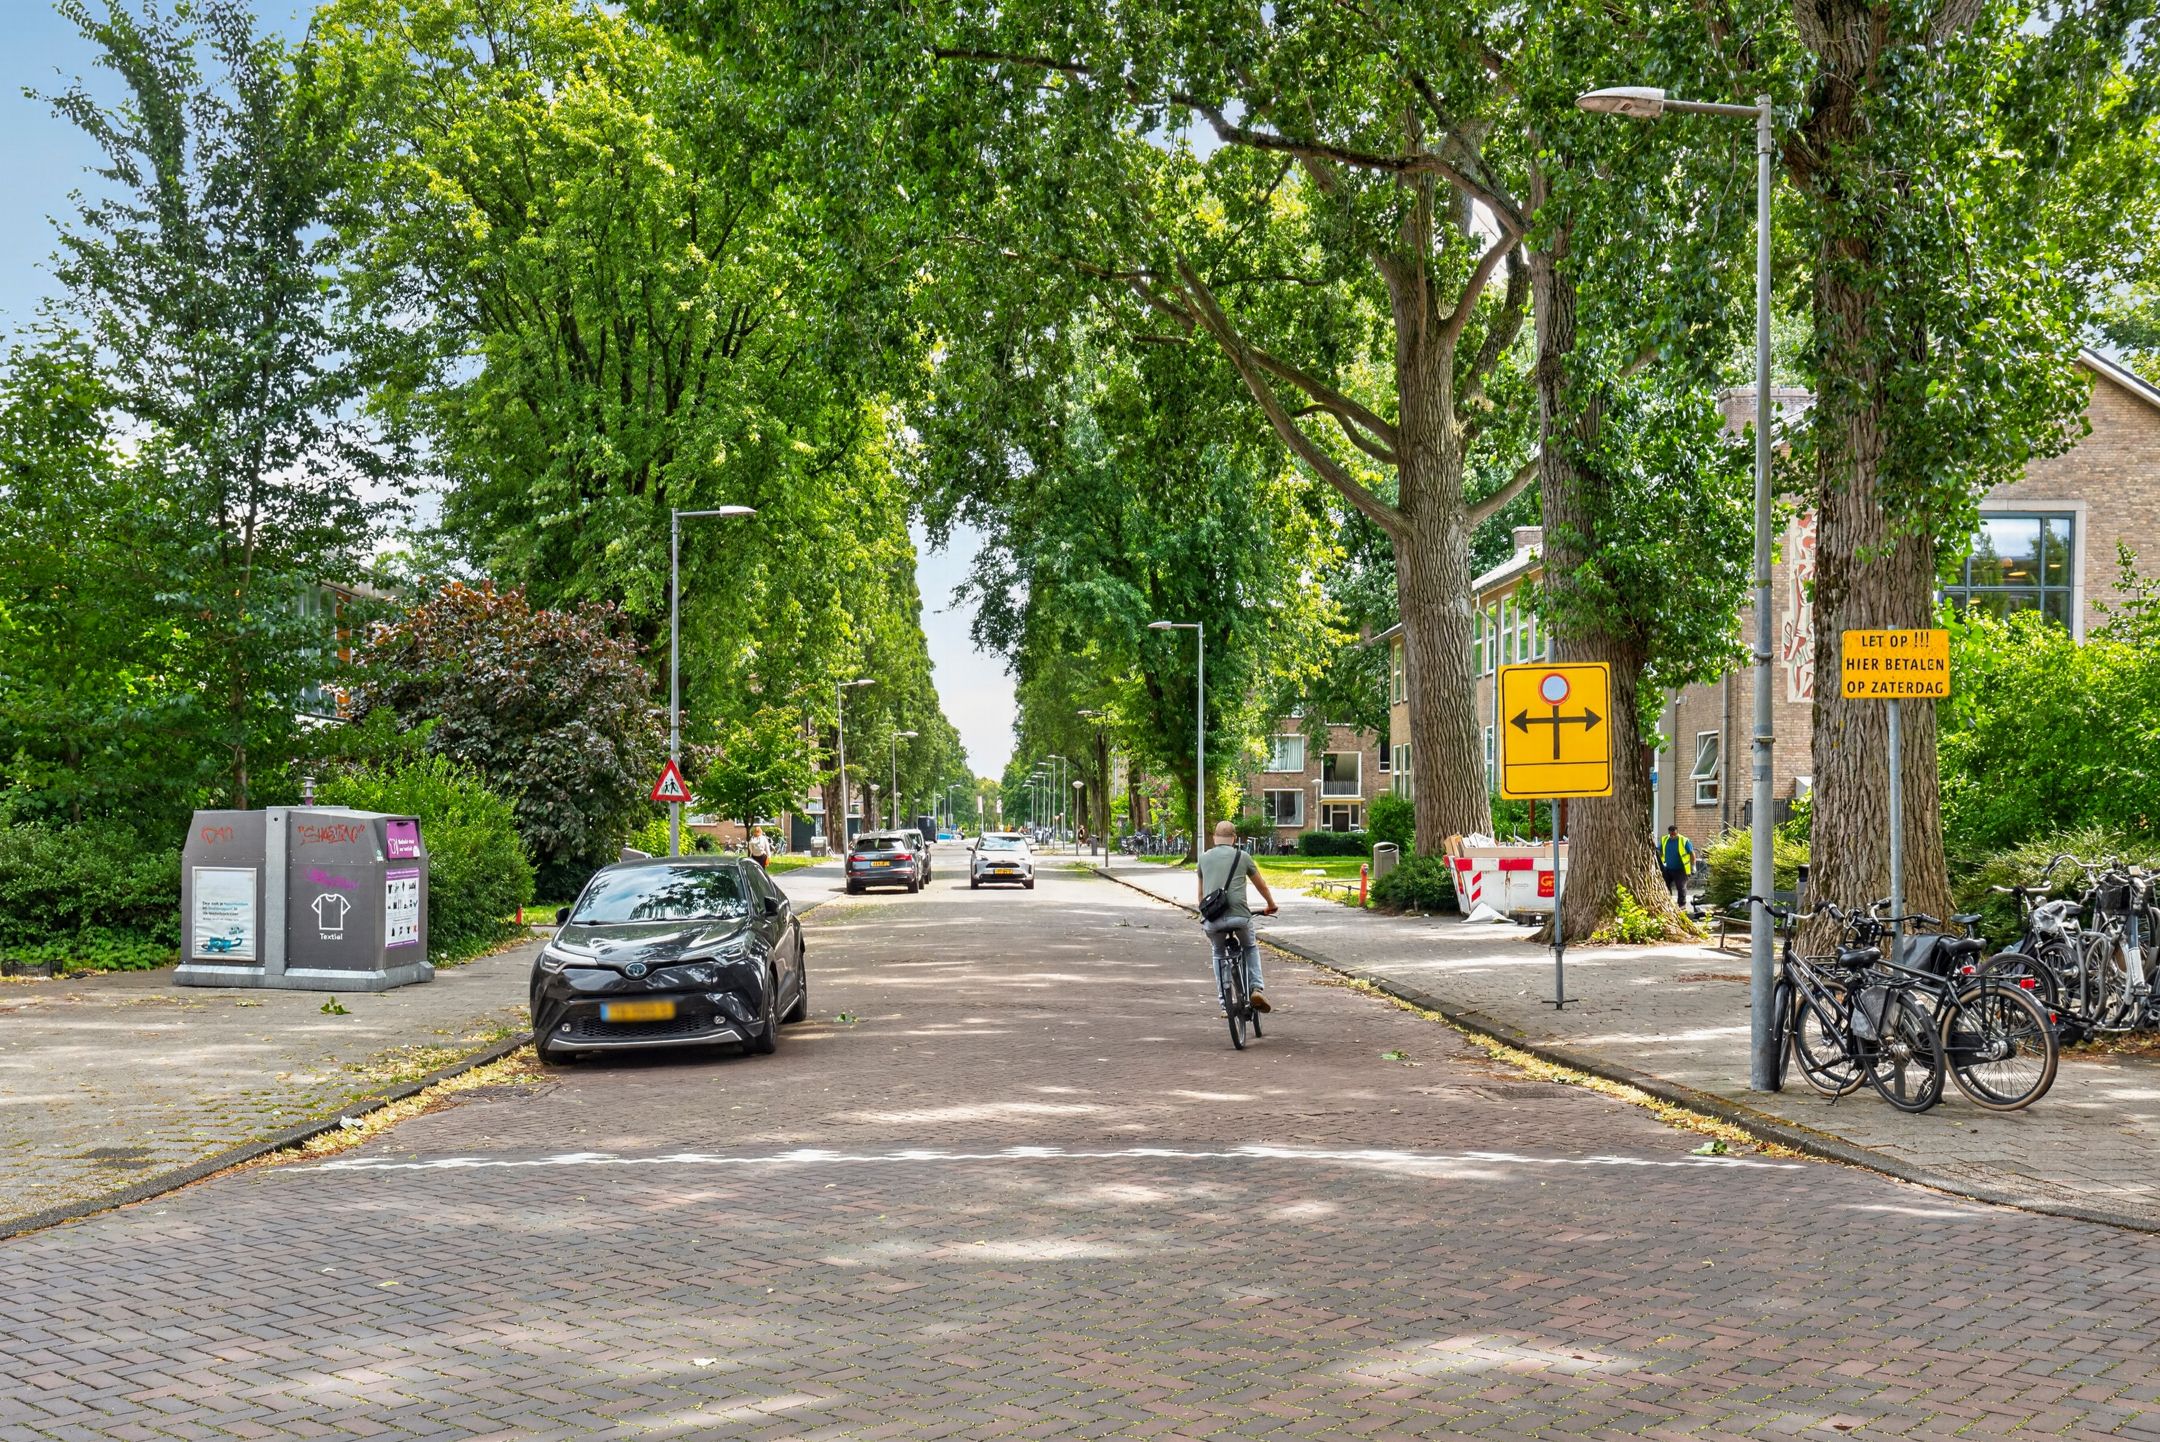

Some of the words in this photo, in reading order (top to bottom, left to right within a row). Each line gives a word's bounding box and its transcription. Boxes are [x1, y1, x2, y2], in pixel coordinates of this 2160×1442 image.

[1861, 635, 1884, 647] LET
[1890, 635, 1908, 647] OP
[1914, 631, 1929, 648] !!!
[1846, 658, 1879, 670] HIER
[1885, 658, 1944, 671] BETALEN
[1847, 681, 1865, 693] OP
[1871, 681, 1943, 694] ZATERDAG
